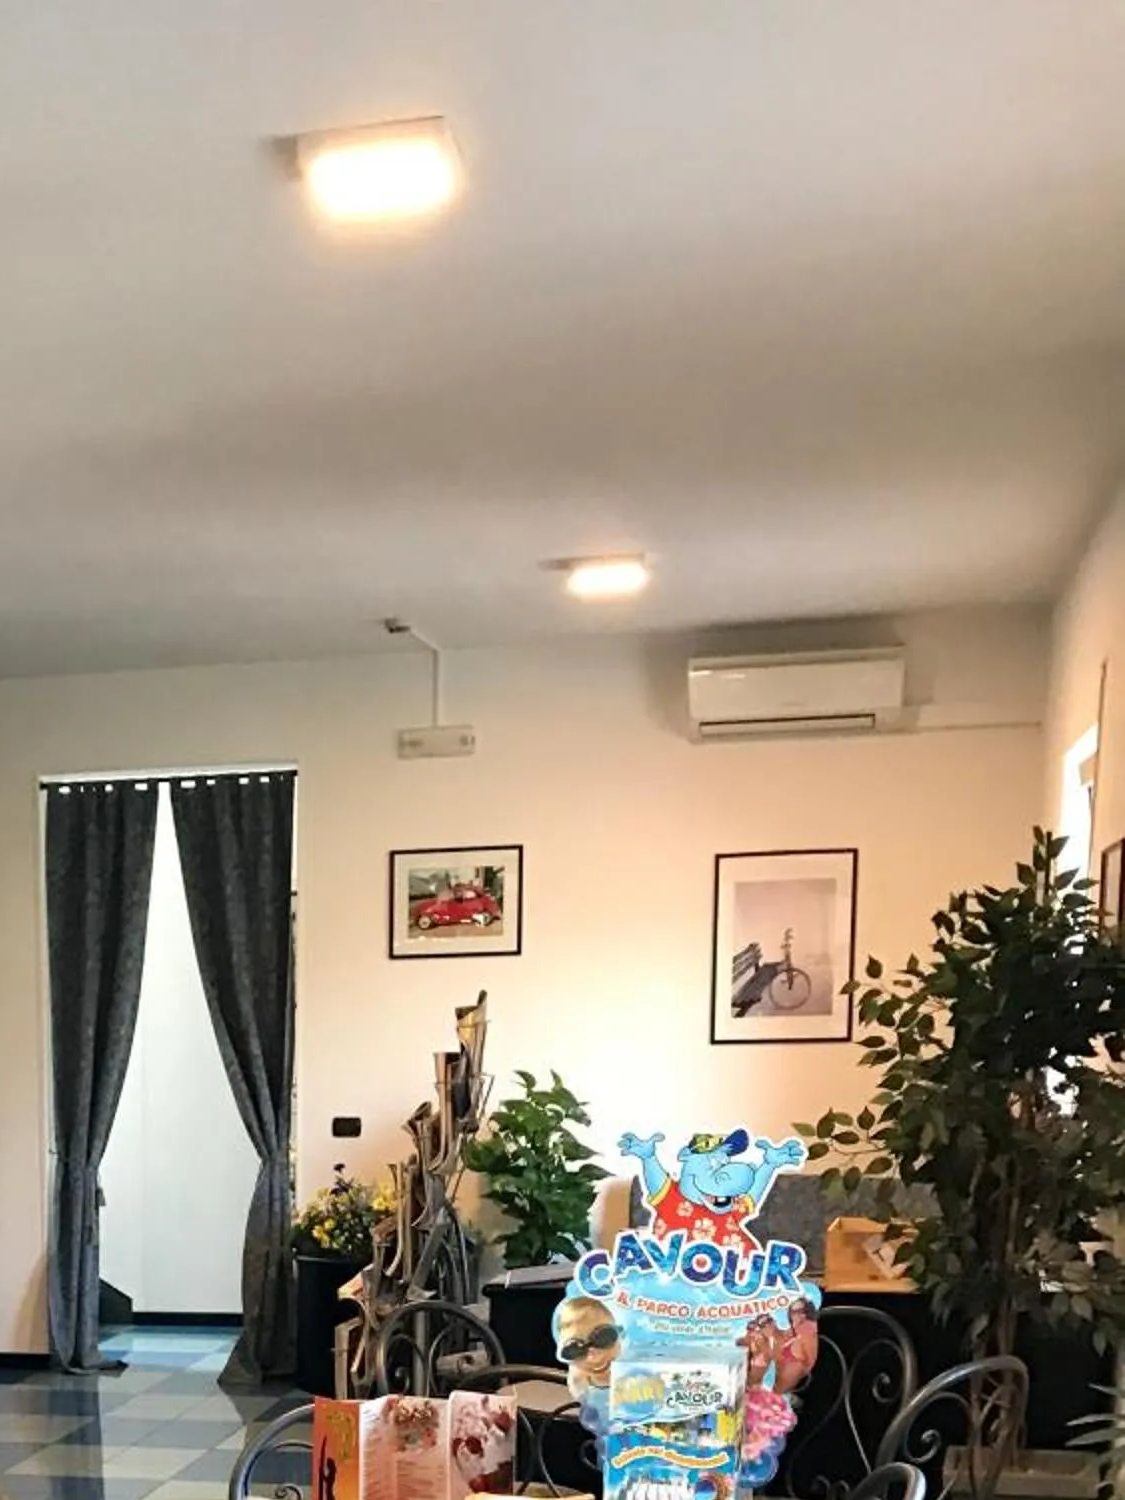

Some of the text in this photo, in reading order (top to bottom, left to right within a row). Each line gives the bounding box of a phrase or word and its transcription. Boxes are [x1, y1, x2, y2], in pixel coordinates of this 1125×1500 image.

[577, 1232, 803, 1298] CAVOUR
[636, 1298, 691, 1318] PARCO
[697, 1295, 791, 1319] ACQUATICO
[665, 1391, 724, 1409] CAVOUR
